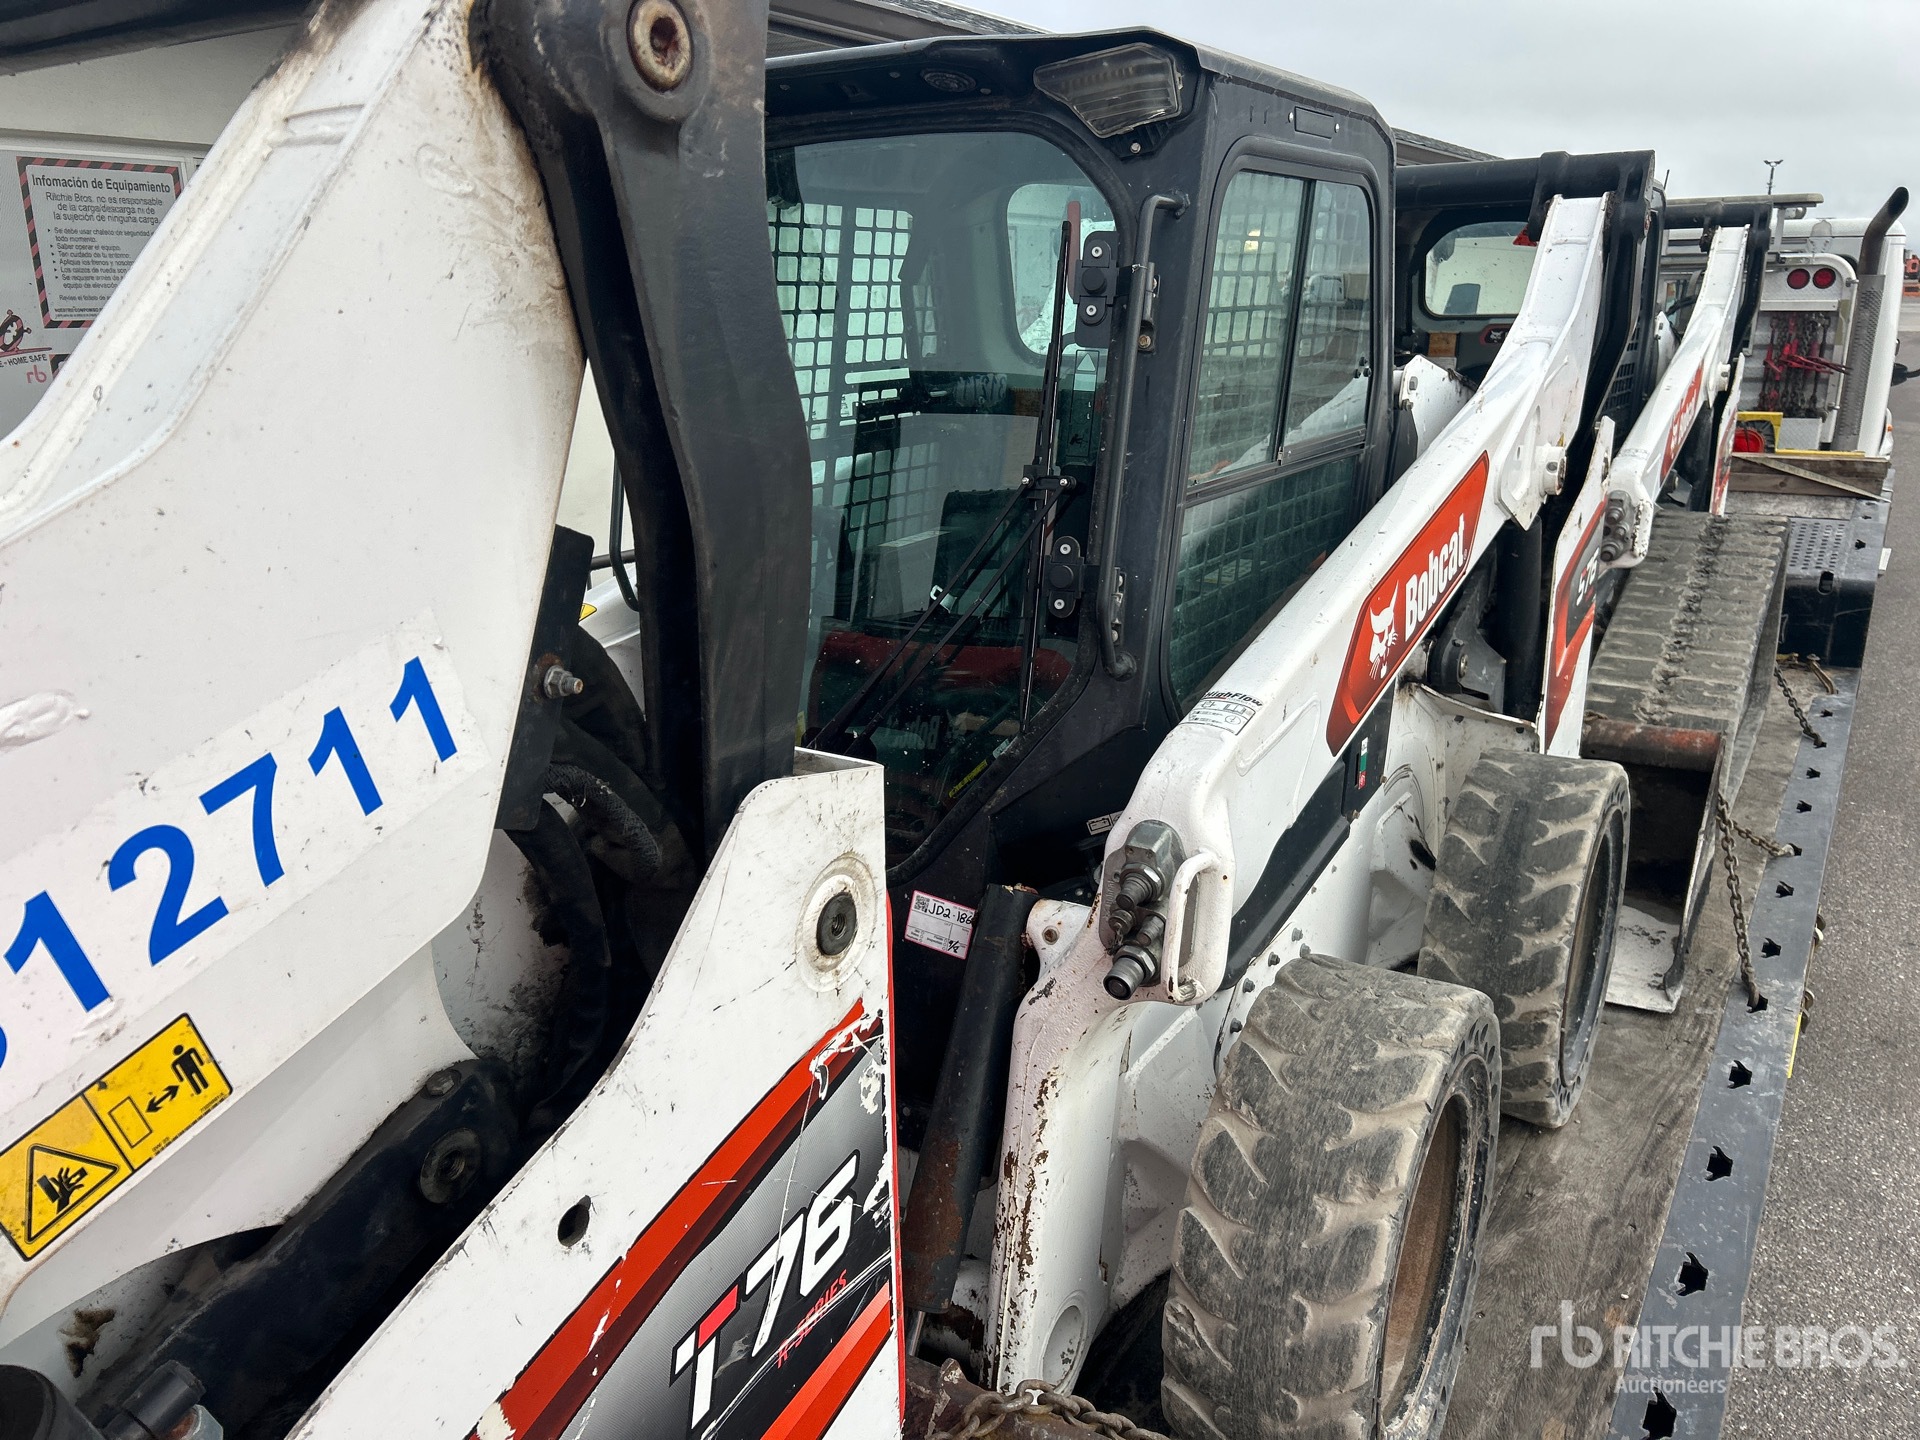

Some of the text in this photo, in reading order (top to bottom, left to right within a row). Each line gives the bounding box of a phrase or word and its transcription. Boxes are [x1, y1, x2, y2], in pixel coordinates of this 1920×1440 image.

[32, 174, 171, 193] Infomación de Equipamiento
[57, 203, 67, 211] de
[146, 207, 155, 215] de
[118, 197, 163, 206] responsable
[53, 212, 61, 220] la
[62, 212, 94, 222] sujeción
[96, 213, 106, 221] de
[107, 214, 137, 224] ninguna
[7, 356, 29, 366] HOME
[29, 353, 47, 363] SAFE
[1405, 512, 1465, 642] Bobcat
[0, 655, 458, 1069] 12711
[674, 1153, 858, 1430] T76
